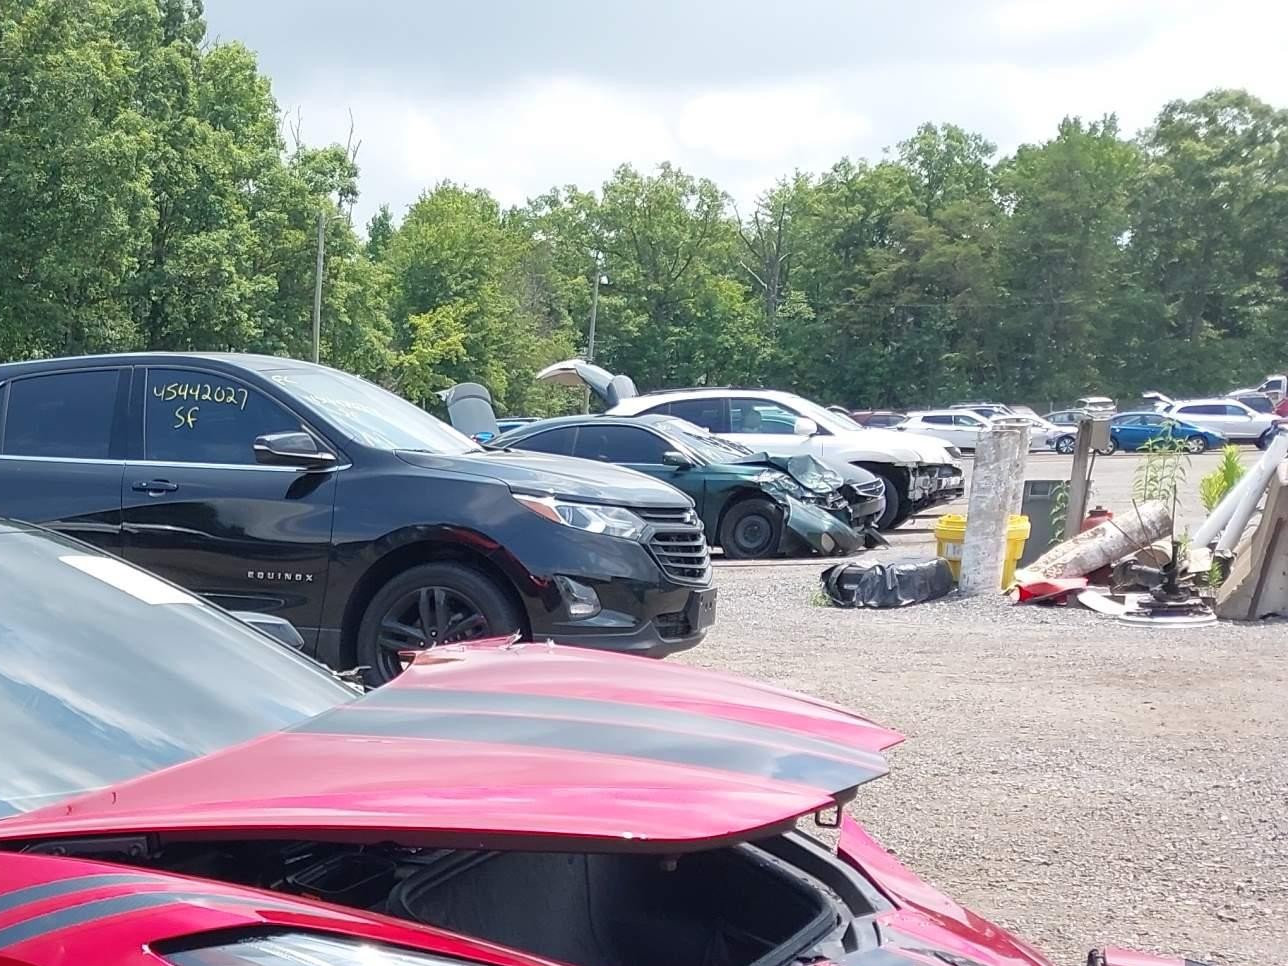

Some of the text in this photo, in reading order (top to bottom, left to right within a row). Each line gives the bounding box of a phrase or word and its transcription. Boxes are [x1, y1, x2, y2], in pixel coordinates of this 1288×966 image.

[153, 383, 249, 411] 45442027
[173, 406, 200, 429] SF
[247, 571, 313, 582] EQUINOX
